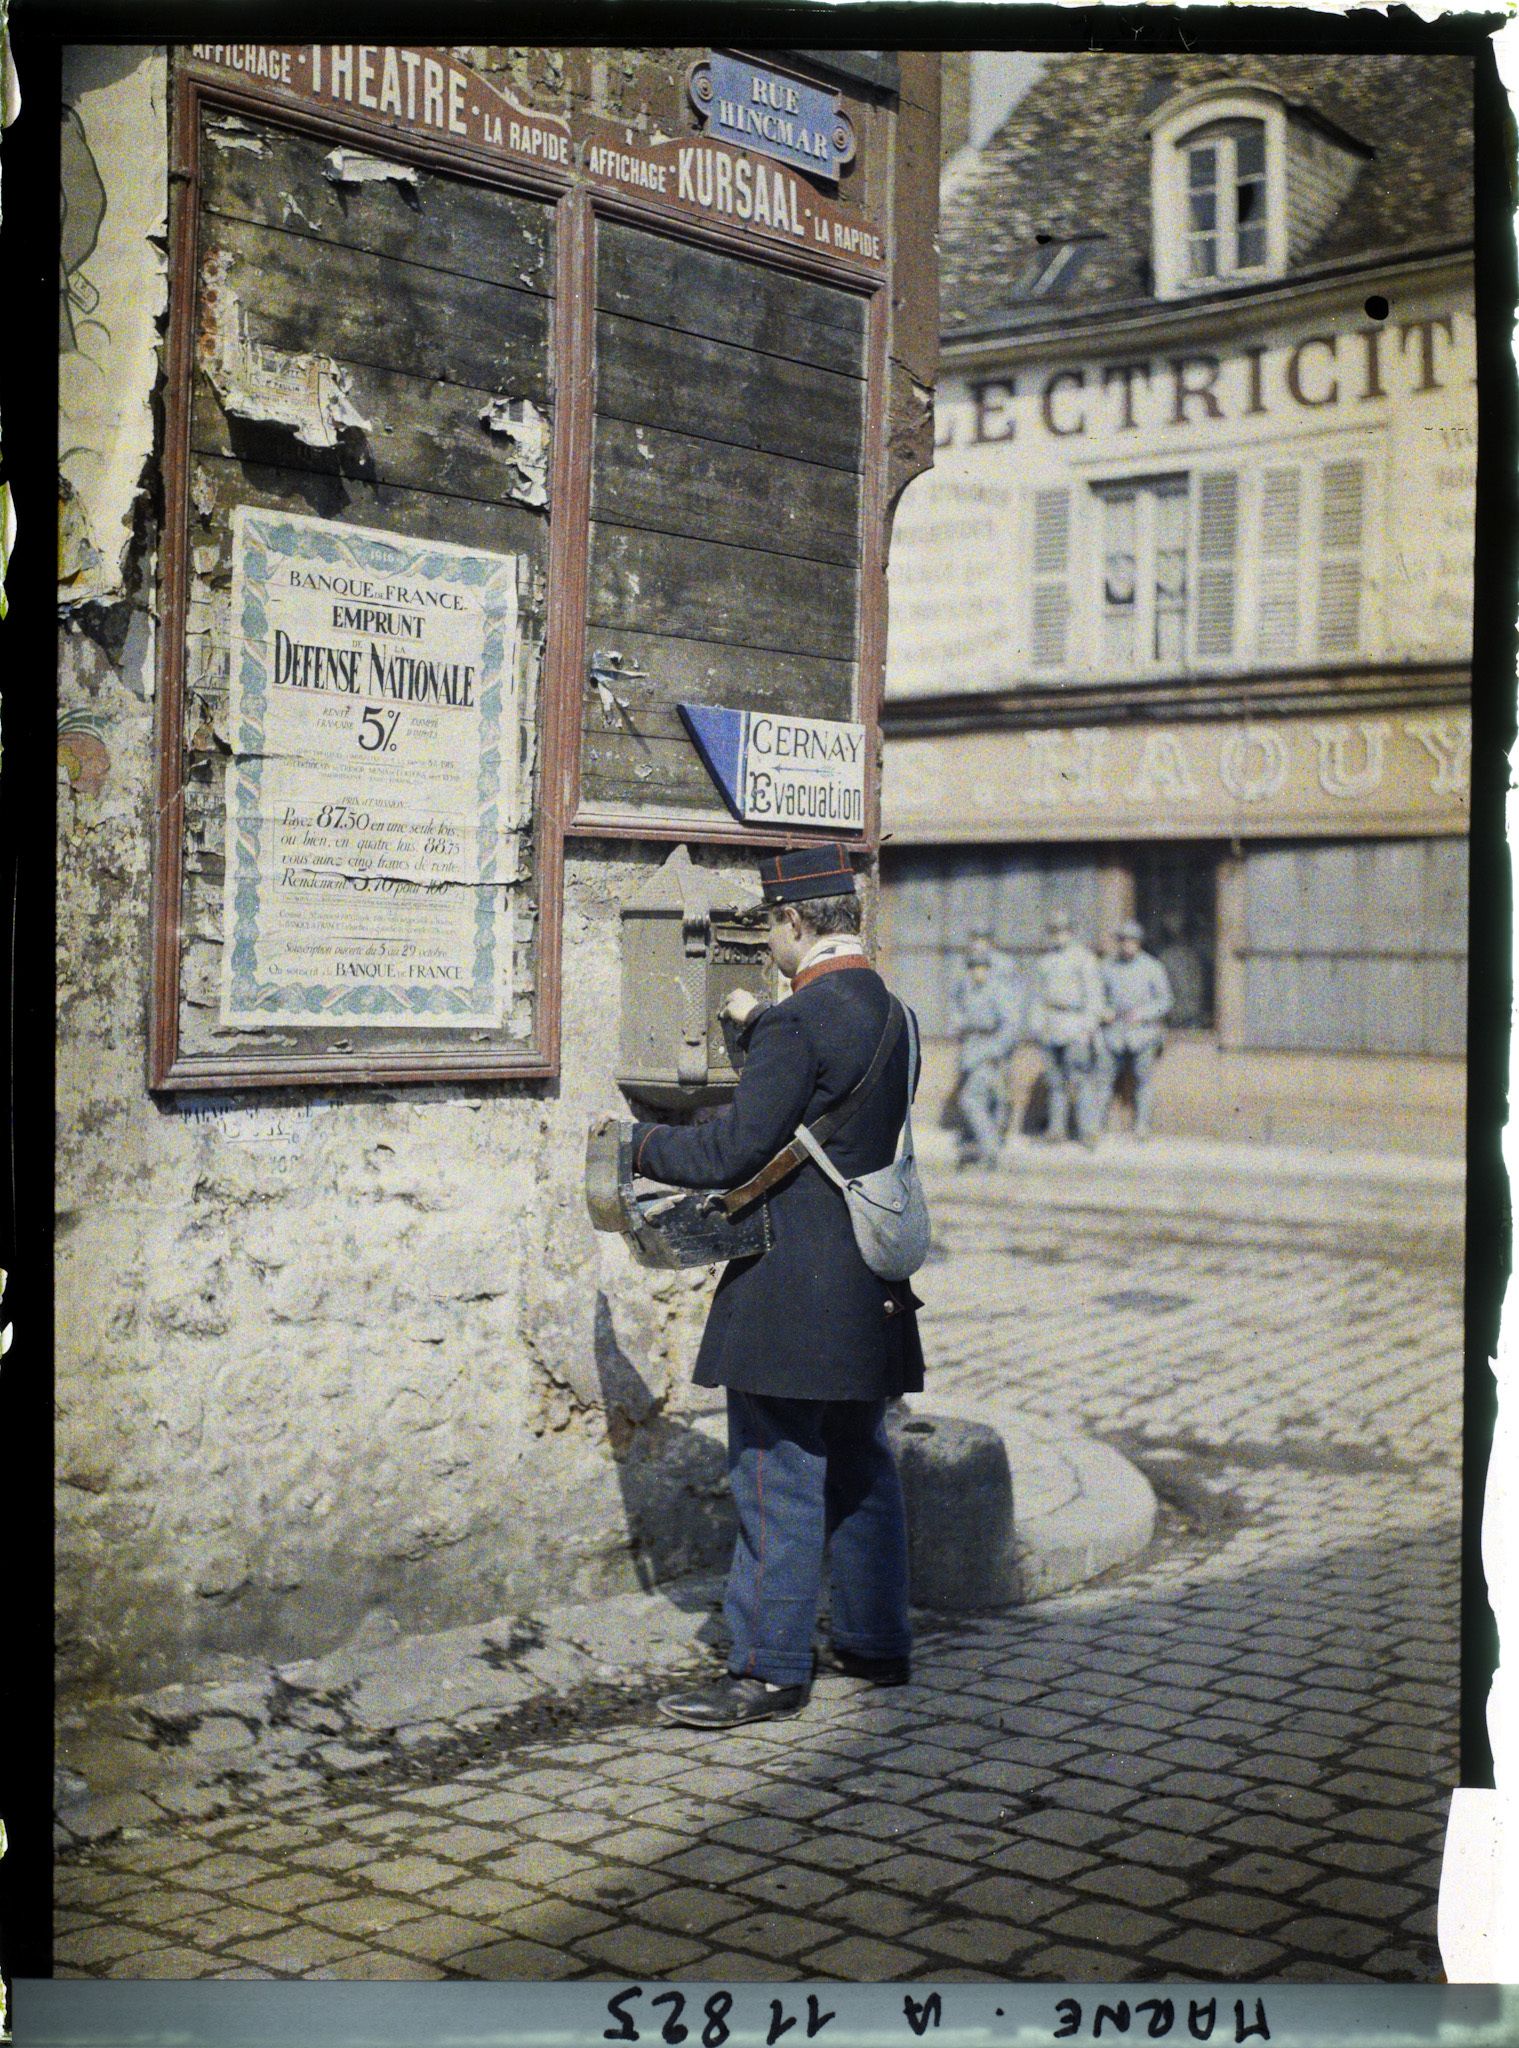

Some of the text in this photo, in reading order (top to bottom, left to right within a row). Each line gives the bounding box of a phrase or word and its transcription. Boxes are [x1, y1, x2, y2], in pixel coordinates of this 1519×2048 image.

[312, 45, 468, 134] THEATRE
[483, 113, 503, 145] LA
[509, 122, 569, 165] RAPIDE
[751, 76, 800, 115] RUE
[719, 100, 828, 160] HINCMAR
[589, 146, 881, 261] AFFICHAGE KURSAAL LA RAPIDE
[935, 312, 1476, 447] ECTRICIT
[290, 570, 375, 598] BANQUE
[386, 585, 465, 610] FRANCE
[332, 605, 426, 638] EMPRUNT
[274, 629, 475, 707] DÉFENSE NATIONALE
[752, 719, 864, 763] CERNAY
[750, 771, 862, 821] Evacuation
[281, 834, 296, 845] ou
[335, 837, 349, 848] en
[282, 807, 312, 829] Payez
[371, 821, 385, 832] en
[387, 822, 407, 833] une
[409, 818, 434, 834] seule
[335, 961, 396, 979] BANQUE
[409, 964, 465, 980] FRANCE
